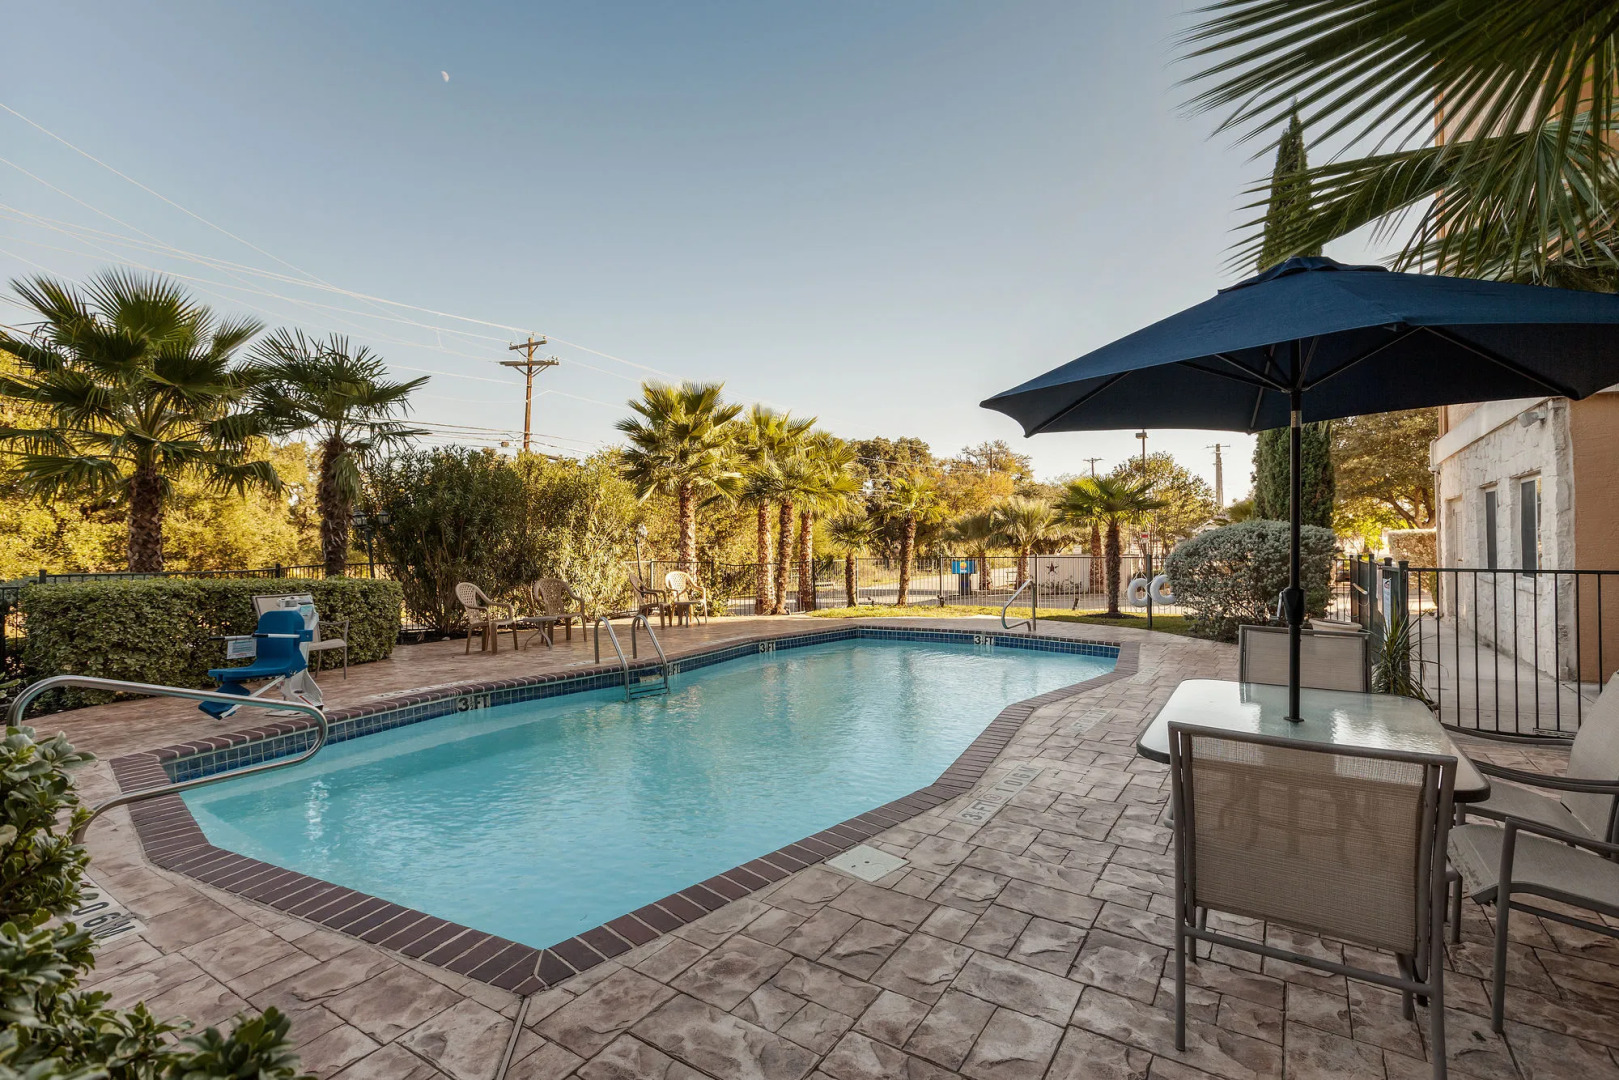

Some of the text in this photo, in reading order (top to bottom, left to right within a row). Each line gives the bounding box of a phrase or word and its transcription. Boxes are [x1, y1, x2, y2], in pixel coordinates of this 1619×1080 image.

[984, 635, 993, 645] FT
[767, 641, 775, 652] FT
[474, 693, 489, 709] FT
